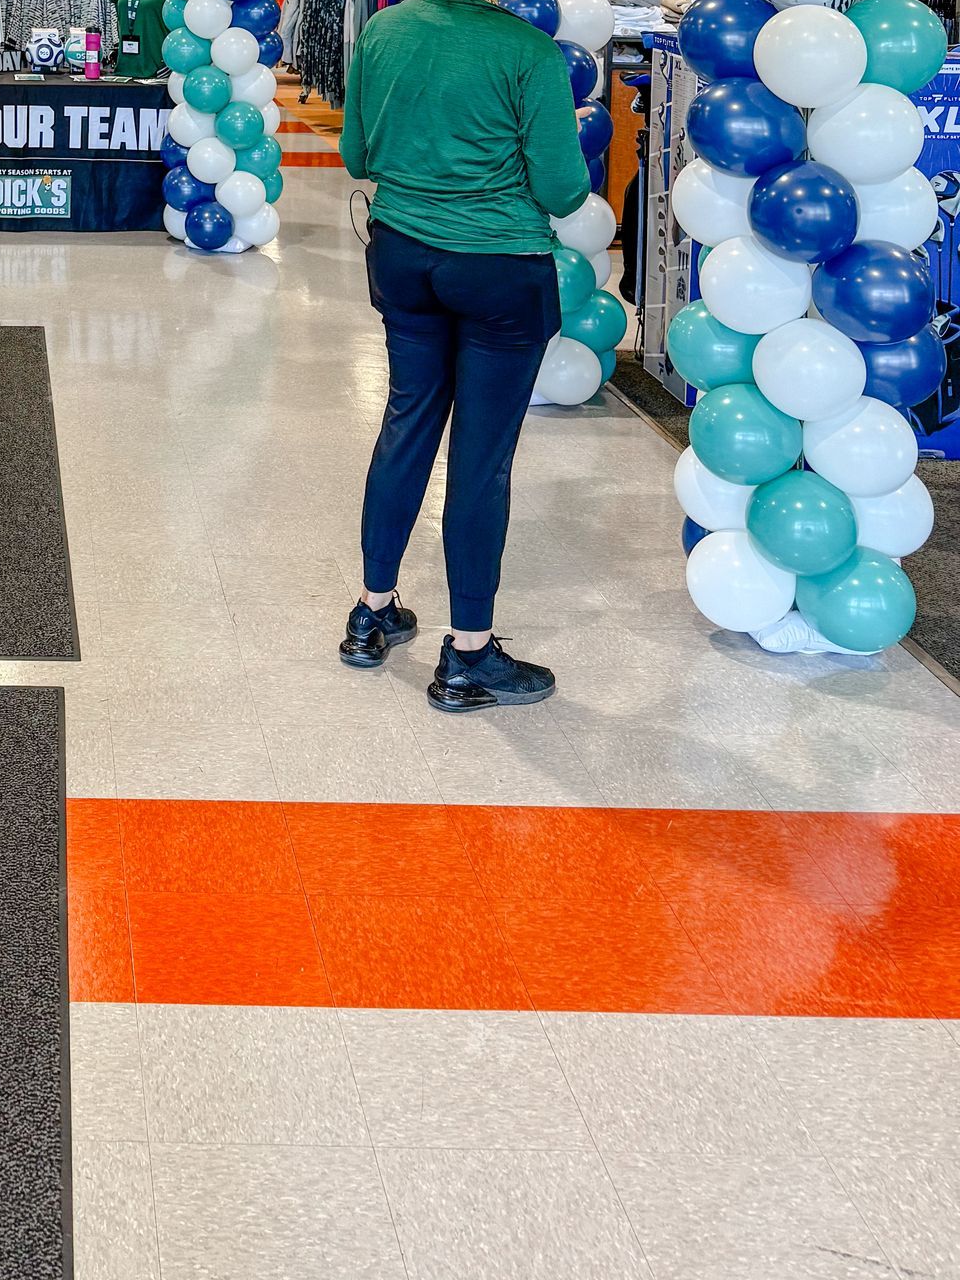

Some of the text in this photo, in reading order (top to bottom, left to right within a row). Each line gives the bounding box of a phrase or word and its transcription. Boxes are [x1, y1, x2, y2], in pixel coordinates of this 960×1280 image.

[917, 105, 960, 133] XL
[64, 106, 173, 151] TEAM
[7, 168, 34, 176] SEASON
[35, 168, 61, 176] STARTS
[34, 207, 66, 215] GOODS
